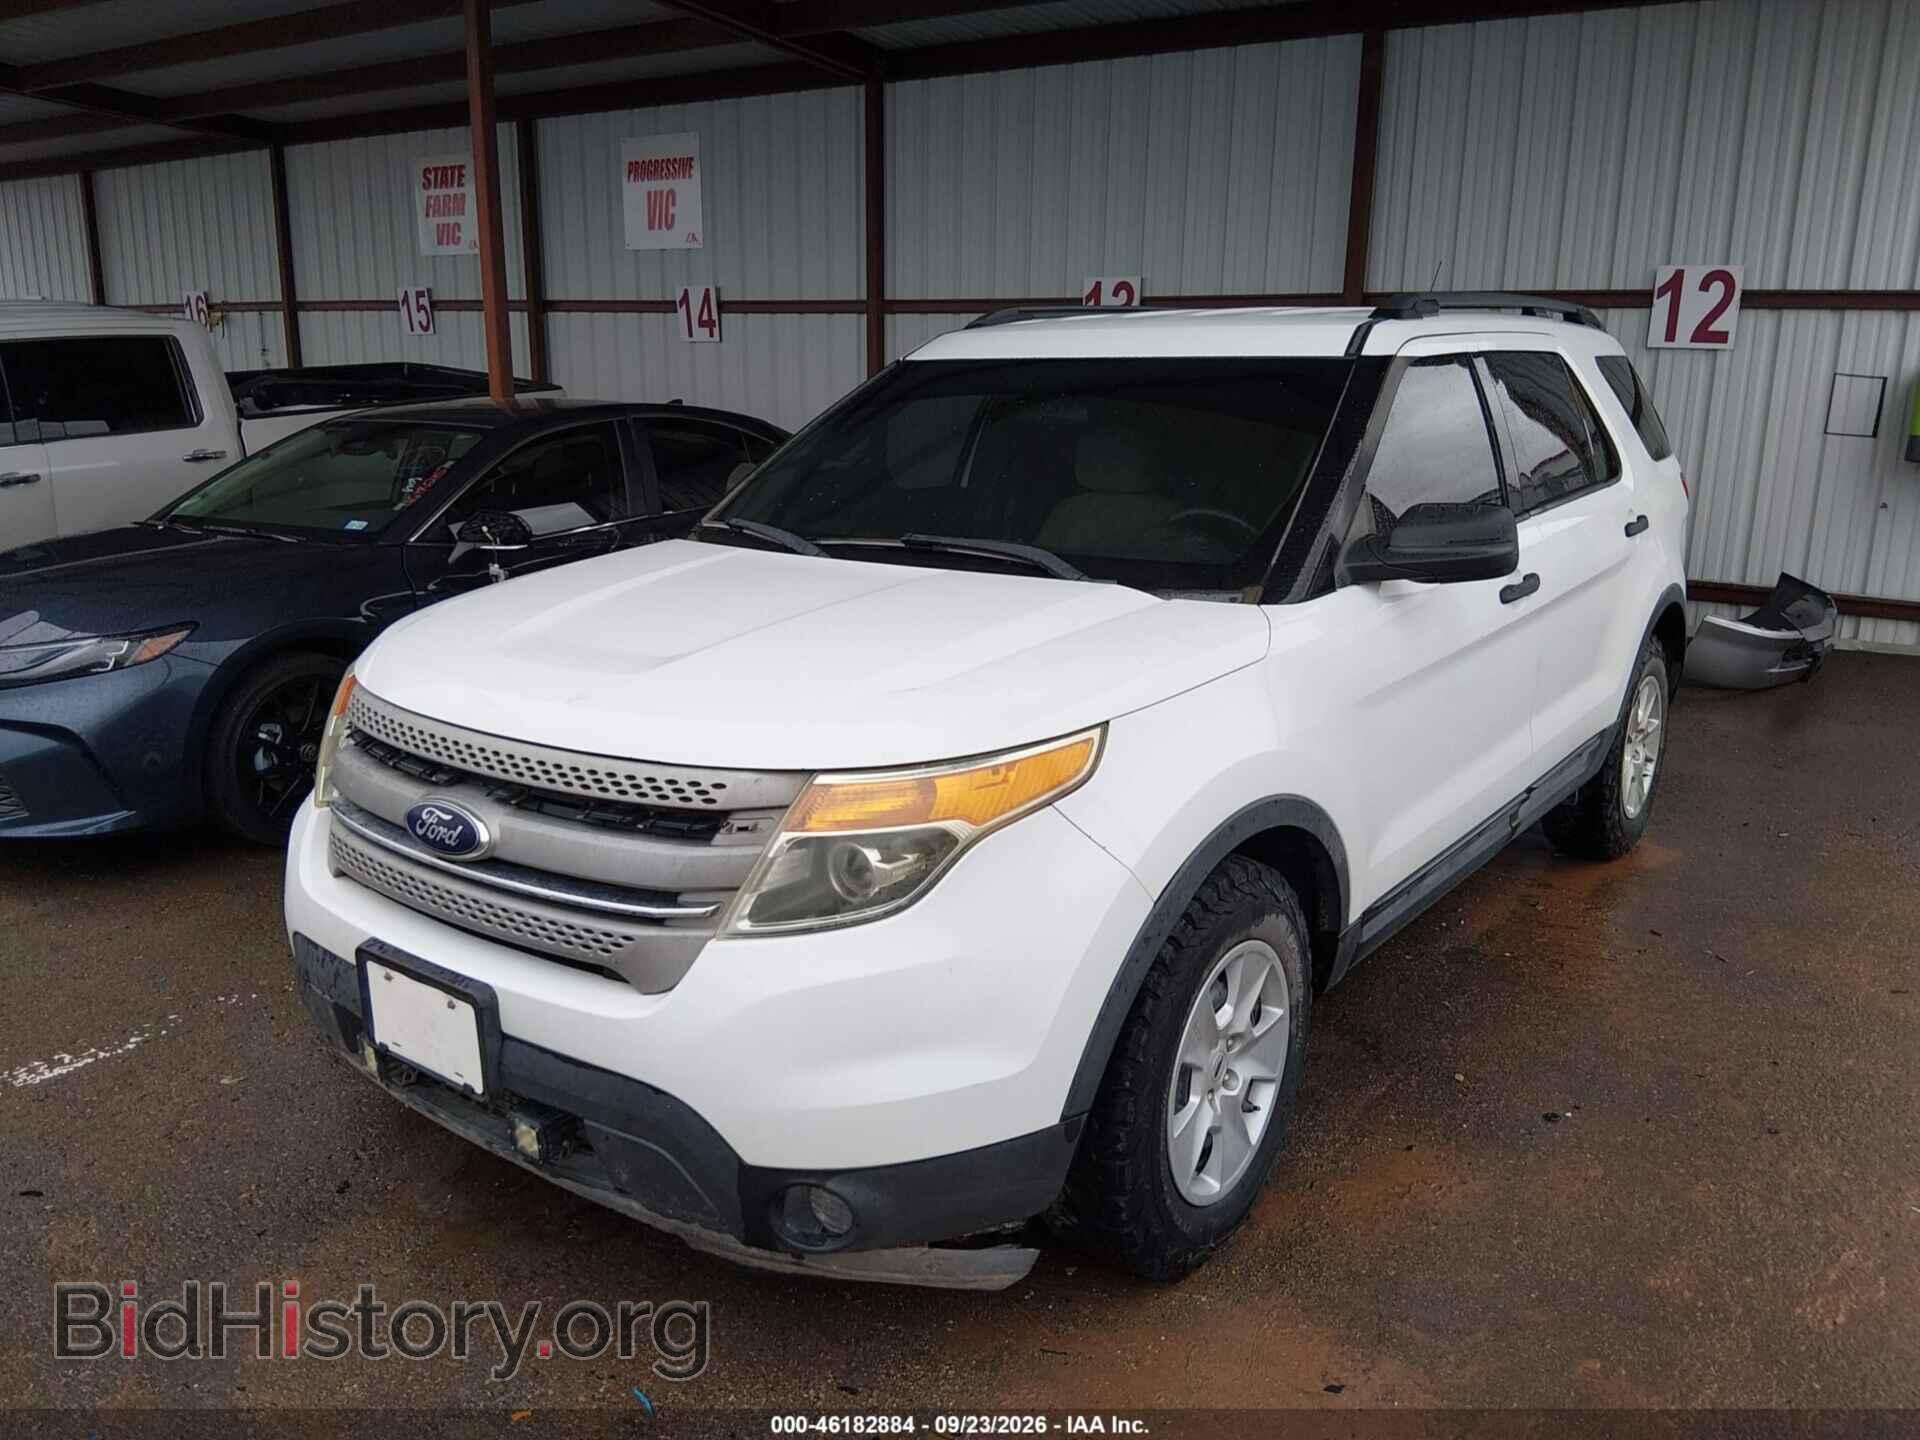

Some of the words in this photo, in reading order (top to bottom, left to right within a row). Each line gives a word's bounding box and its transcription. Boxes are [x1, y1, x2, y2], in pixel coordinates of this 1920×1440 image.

[422, 164, 466, 190] STATE
[627, 156, 695, 183] PROGRESSIVE
[425, 193, 466, 218] FARM
[646, 187, 677, 231] VIC
[436, 222, 462, 246] VIC
[184, 294, 208, 329] 16
[401, 289, 431, 332] 15
[678, 287, 717, 338] 14
[1655, 268, 1736, 344] 12
[415, 807, 463, 847] Ford
